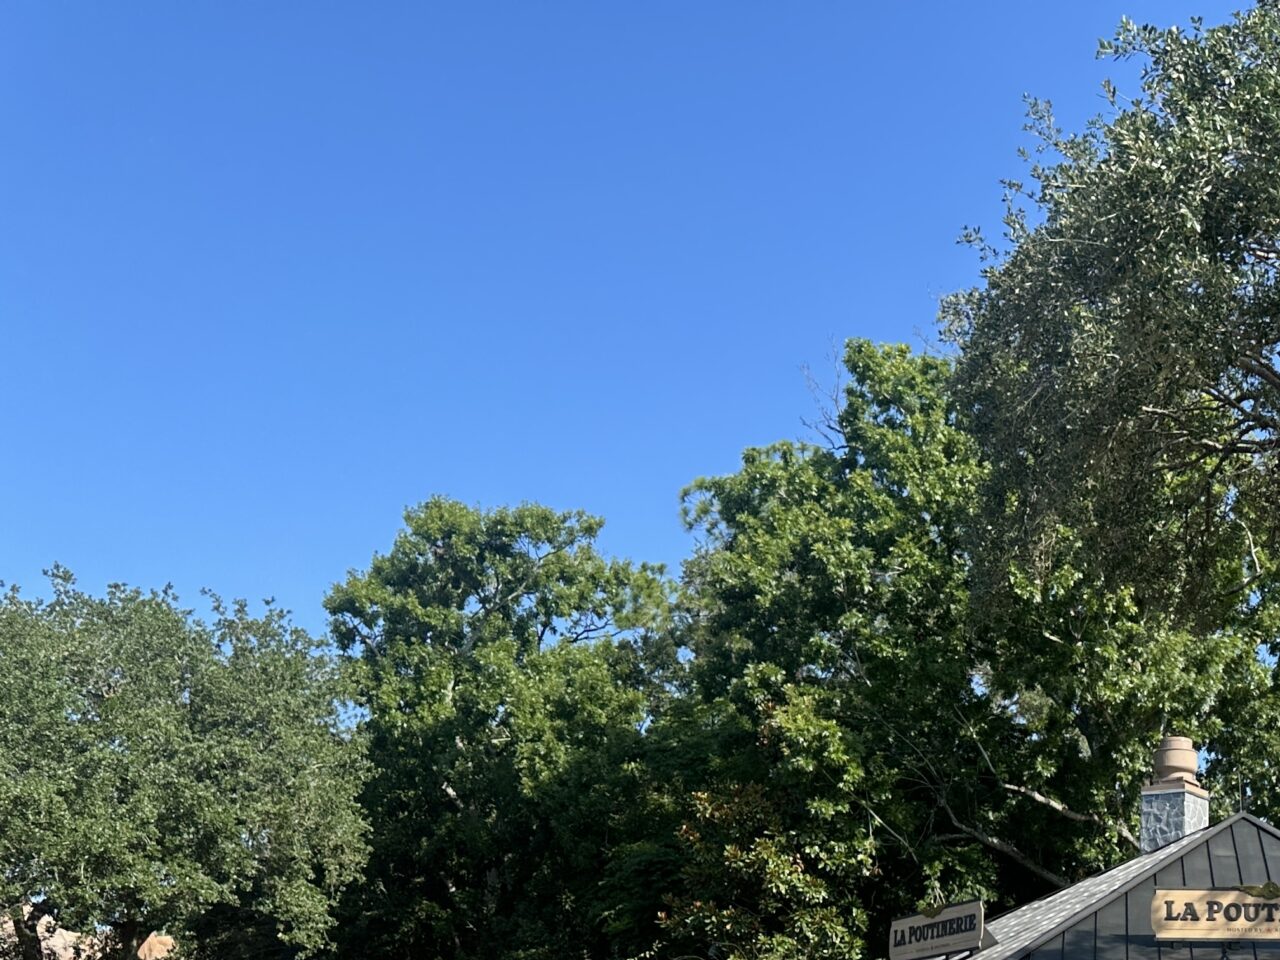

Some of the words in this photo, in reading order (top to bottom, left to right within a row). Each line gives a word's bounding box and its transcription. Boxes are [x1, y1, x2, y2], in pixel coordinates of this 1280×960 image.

[1164, 900, 1199, 922] LA
[893, 929, 906, 948] LA
[908, 913, 977, 945] POUTINERIE
